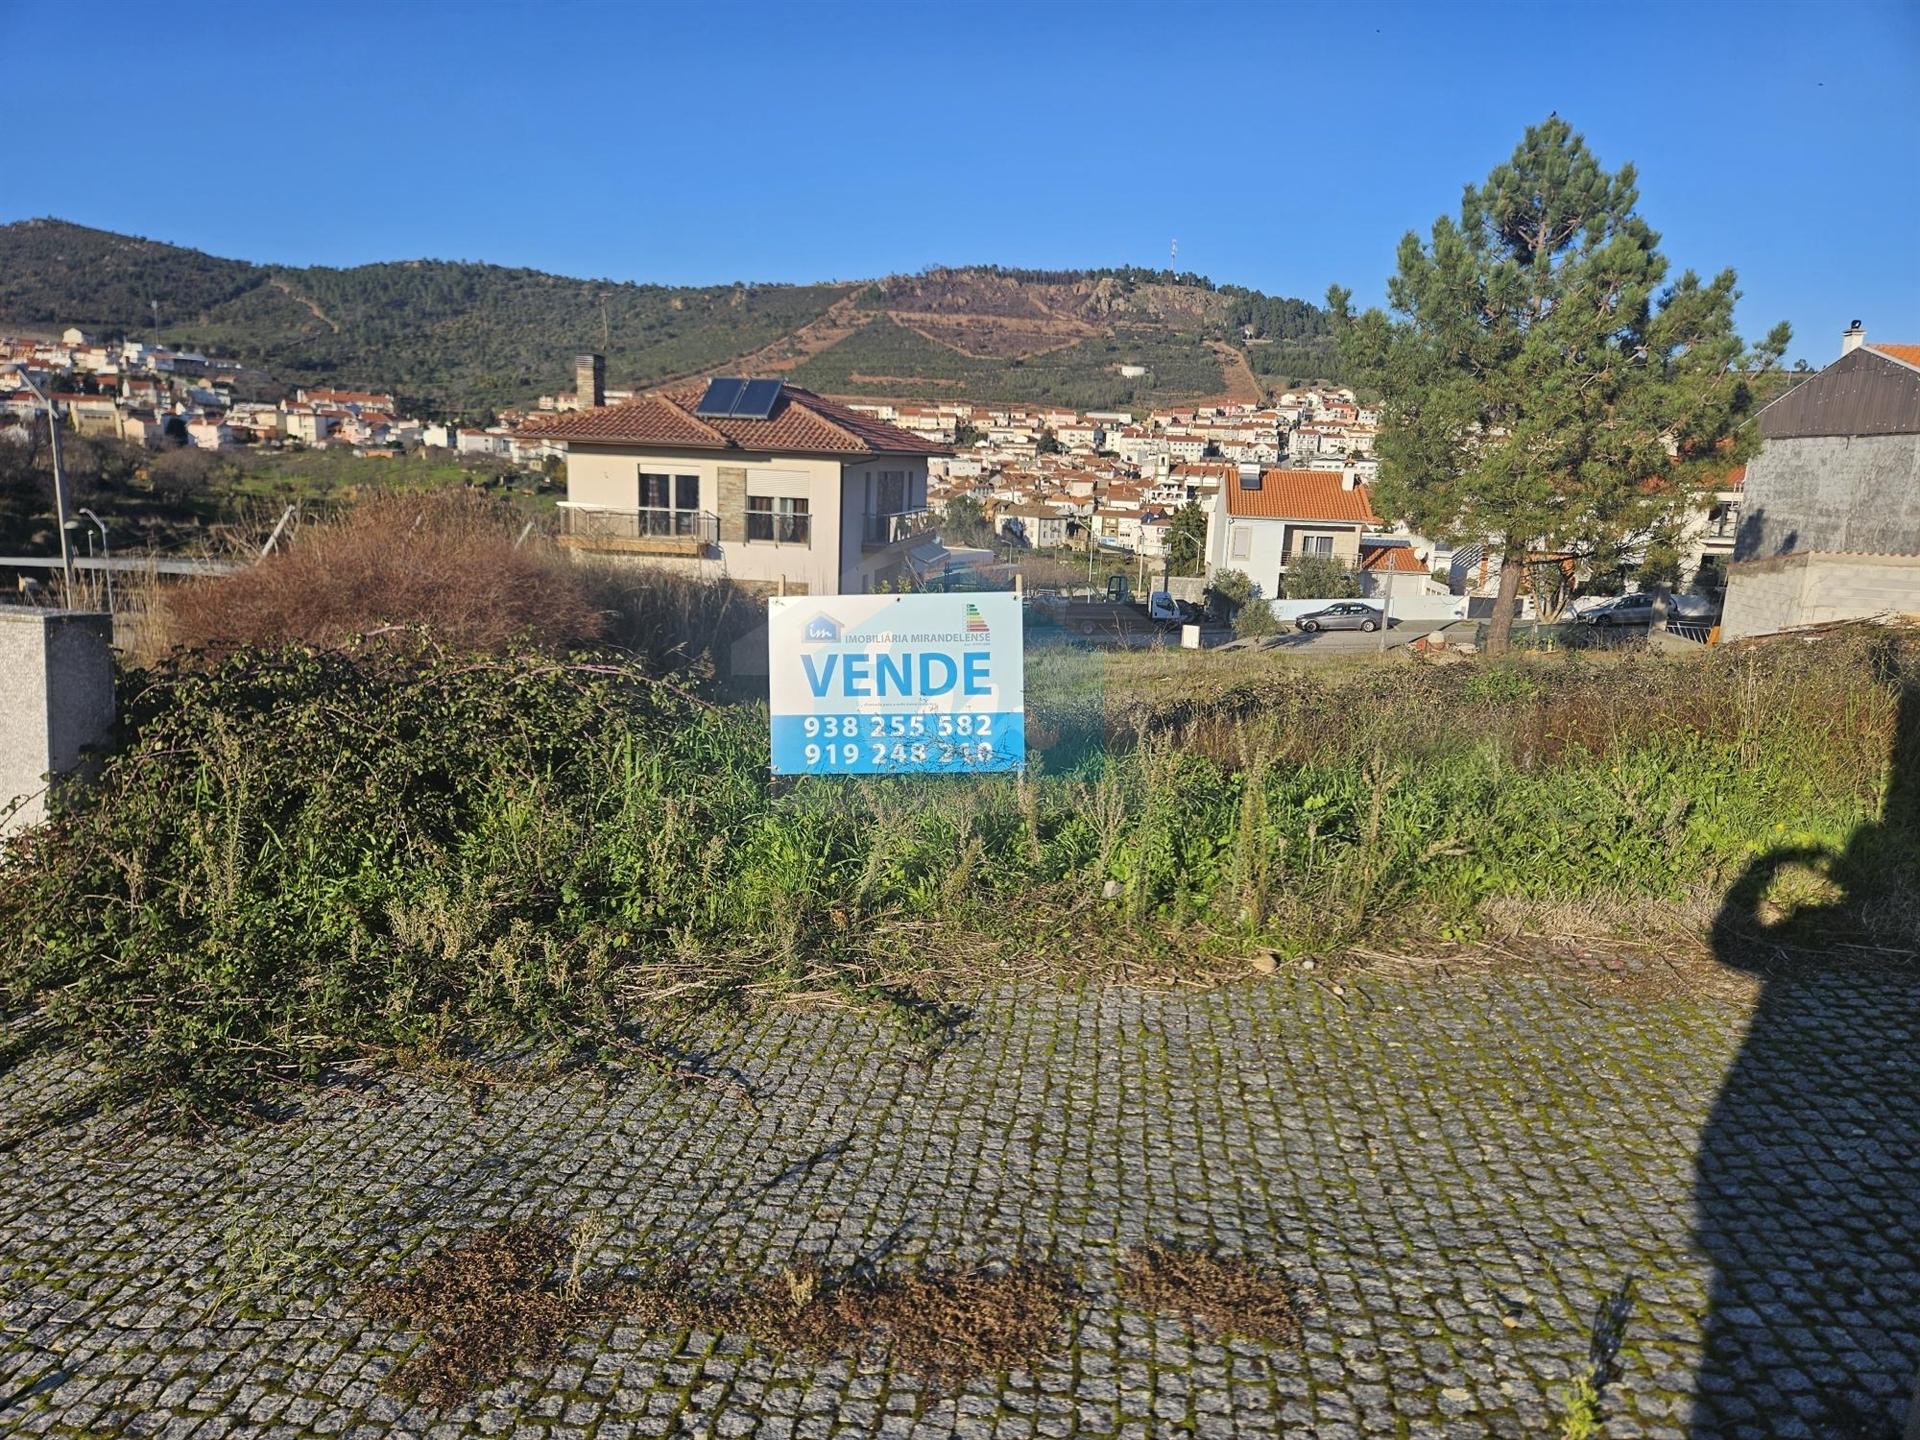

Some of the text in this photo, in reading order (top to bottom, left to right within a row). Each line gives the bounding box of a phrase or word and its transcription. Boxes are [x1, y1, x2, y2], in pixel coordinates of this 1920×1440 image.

[910, 632, 991, 644] MIRANDELENSE
[801, 652, 993, 698] VENDE
[804, 715, 993, 739] 938 255 582
[805, 744, 860, 766] 919
